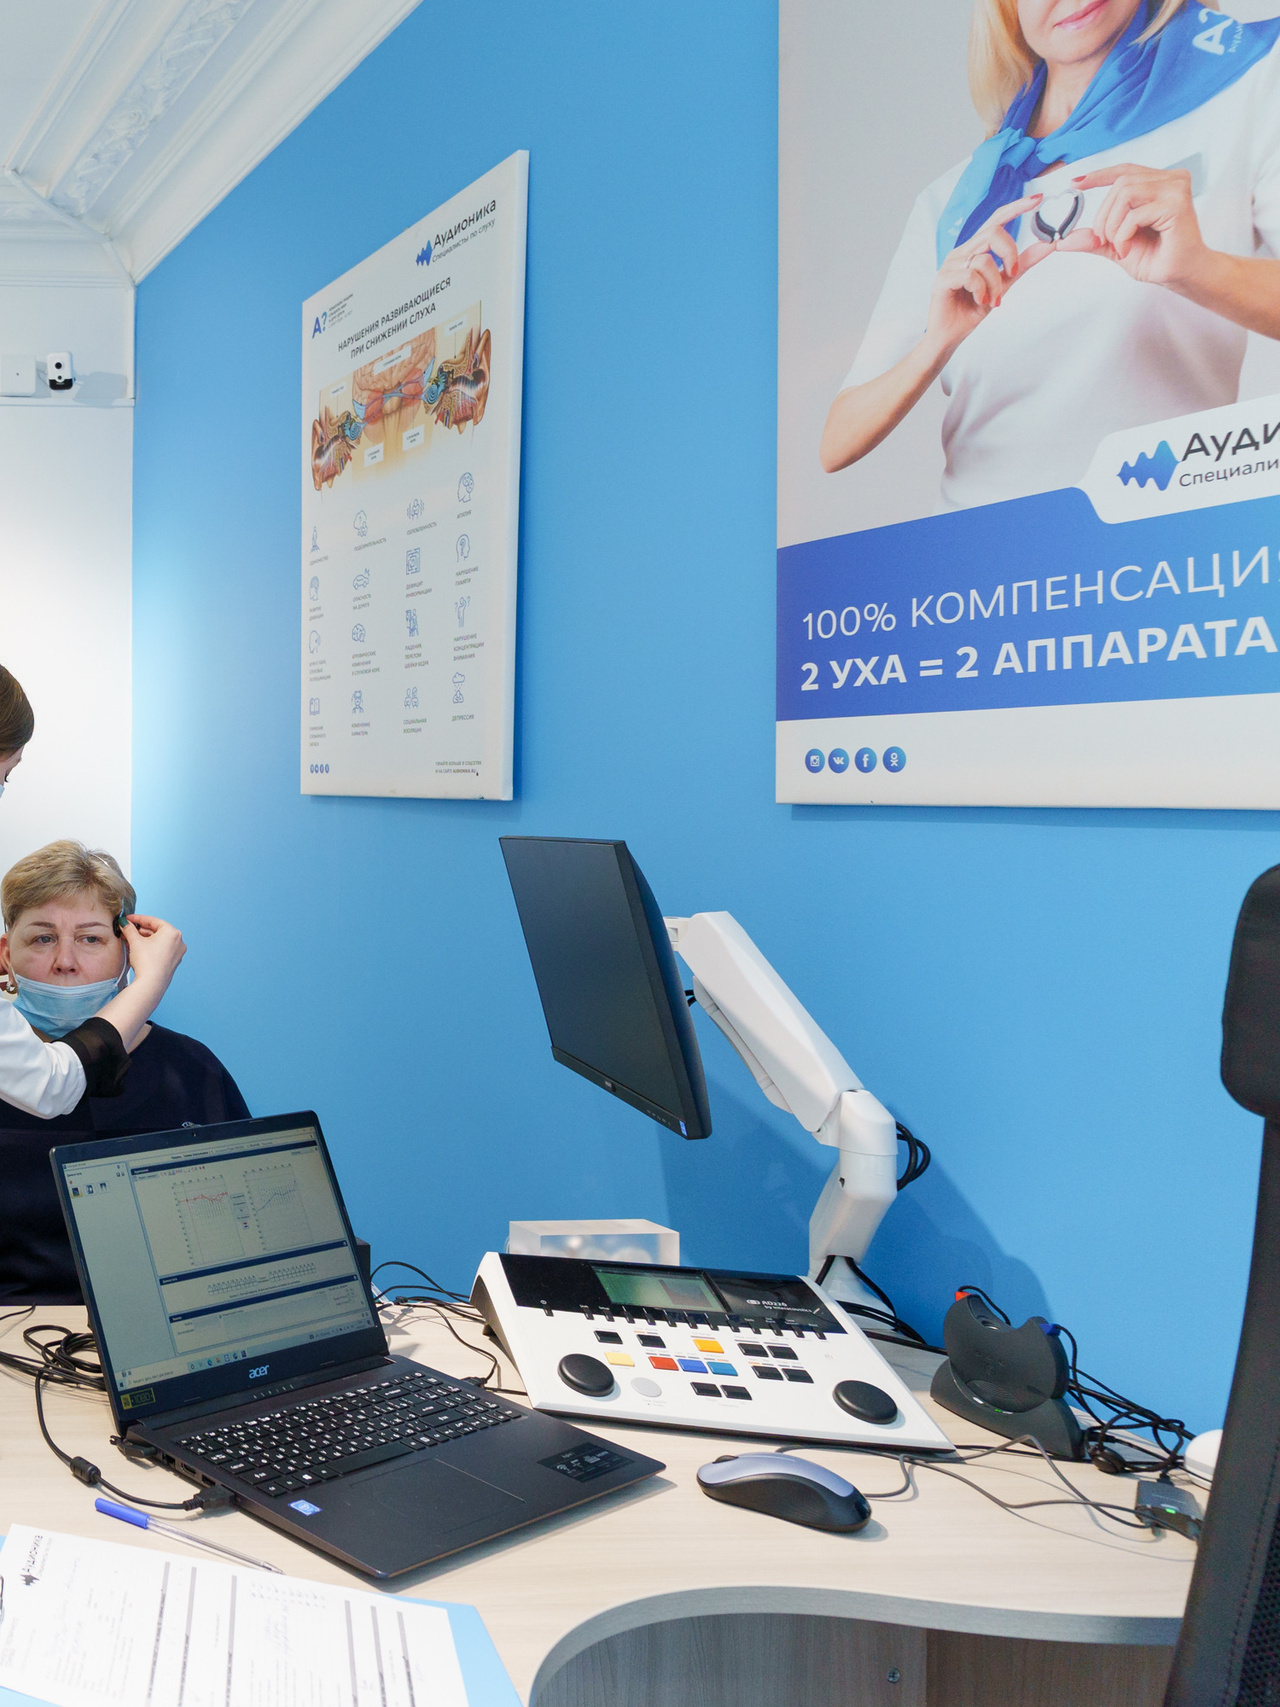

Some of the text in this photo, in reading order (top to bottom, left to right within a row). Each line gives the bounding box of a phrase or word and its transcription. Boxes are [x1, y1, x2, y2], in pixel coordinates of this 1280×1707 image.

[432, 218, 496, 263] Специалисты по слуху
[433, 200, 496, 249] Аудионика
[338, 320, 380, 352] НАРУШЕНИЯ
[381, 276, 451, 326] РАЗВИВАЮЩИЕСЯ
[350, 302, 436, 359] ПРИ СНИЖЕНИИ СЛУХА
[802, 546, 1280, 640] 100% КОМПЕНСАЦИ
[801, 663, 819, 691] 2
[829, 655, 907, 689] УХА
[955, 646, 978, 679] 2
[993, 616, 1278, 675] АППАРАТА
[248, 1365, 270, 1379] acer
